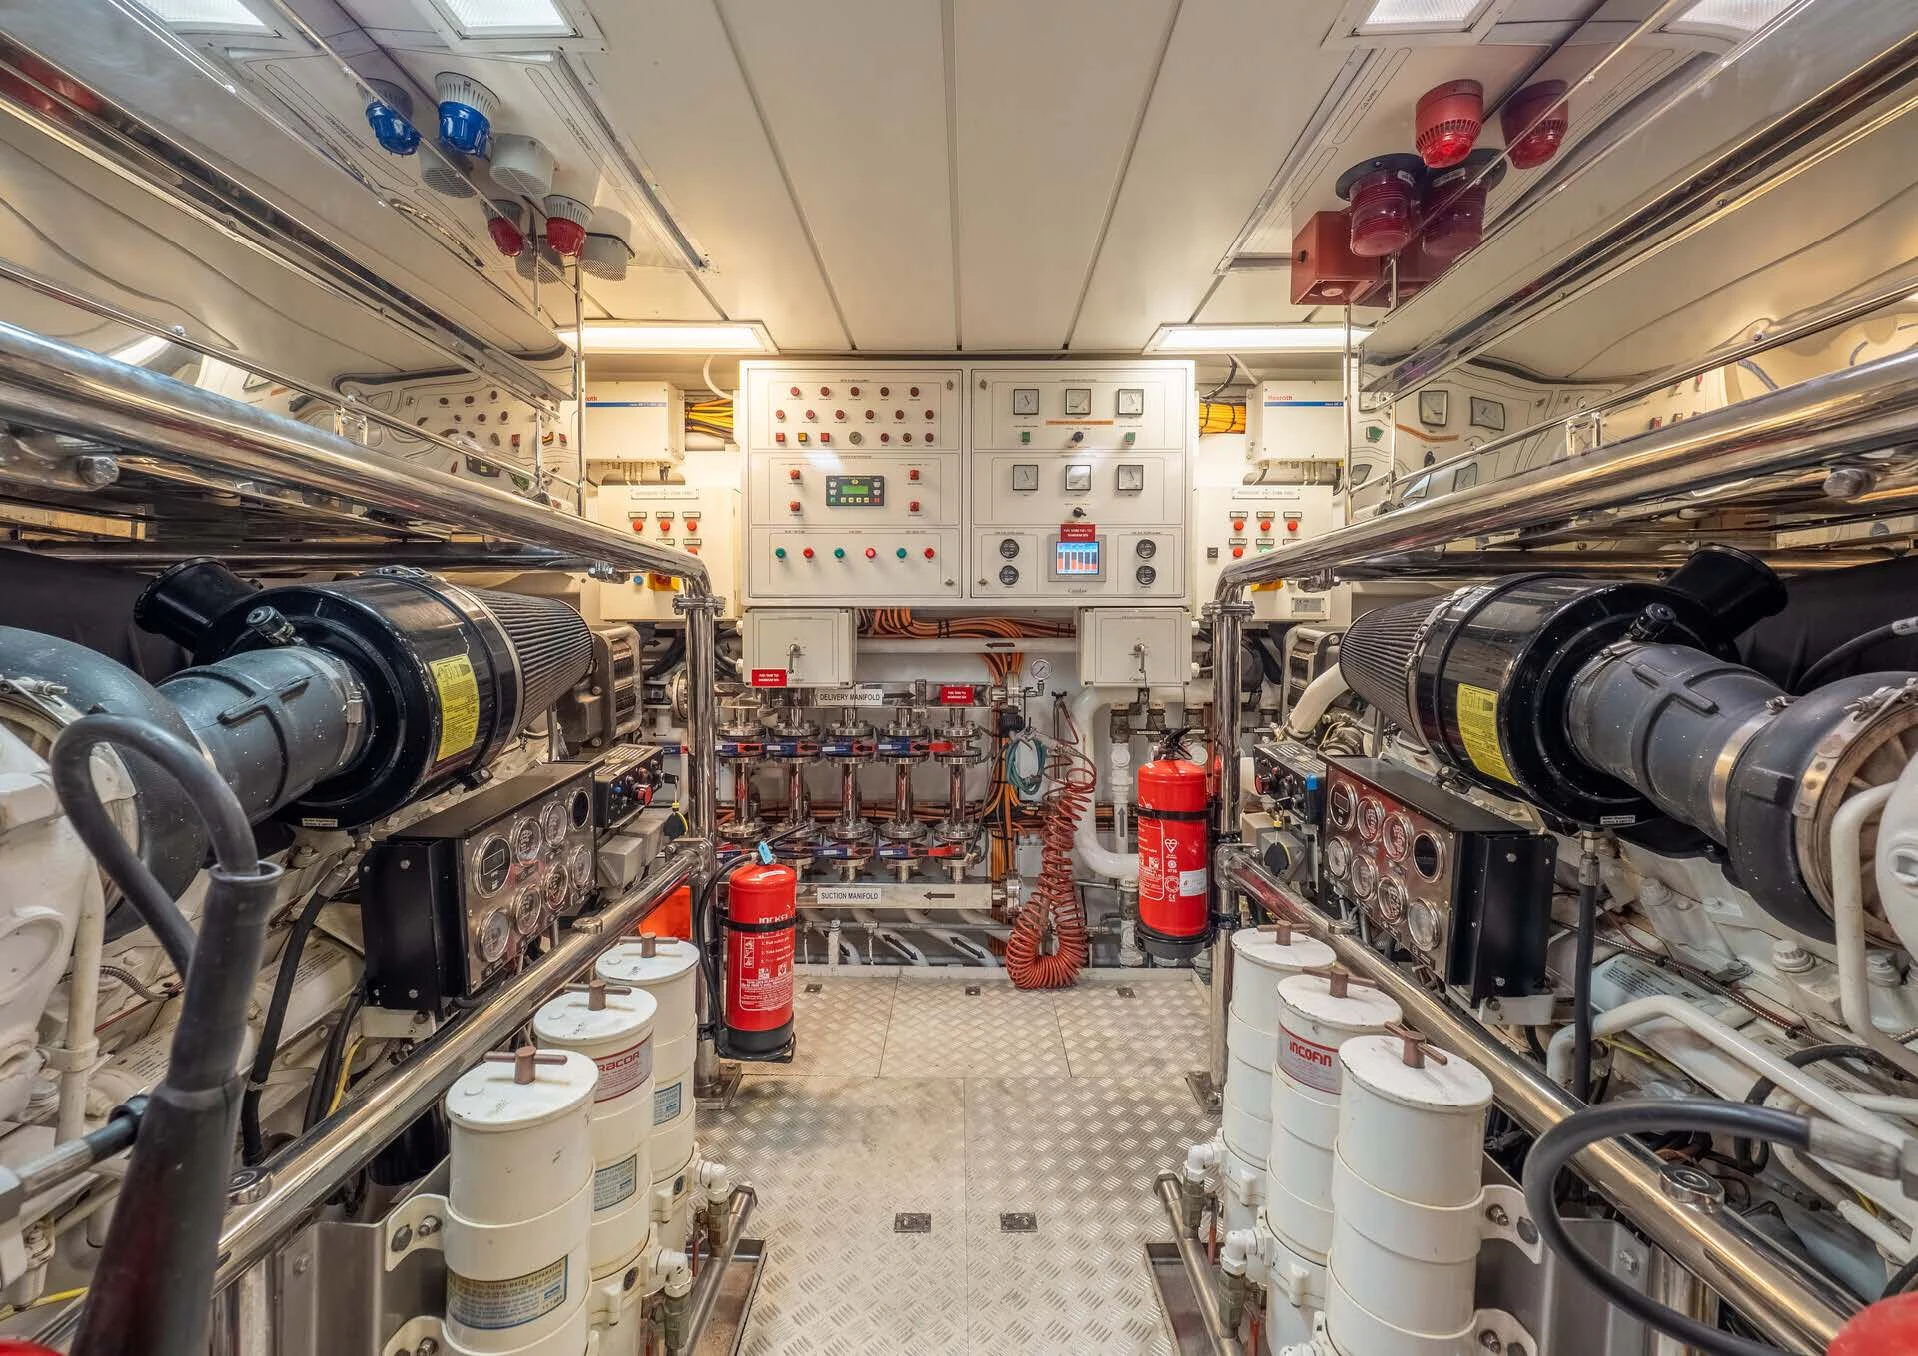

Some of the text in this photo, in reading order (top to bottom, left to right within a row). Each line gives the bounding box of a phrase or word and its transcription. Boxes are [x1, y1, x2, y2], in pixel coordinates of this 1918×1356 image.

[819, 693, 881, 701] DELIVERY MANIFOLD
[821, 892, 879, 900] SUCTION MANIFOLD
